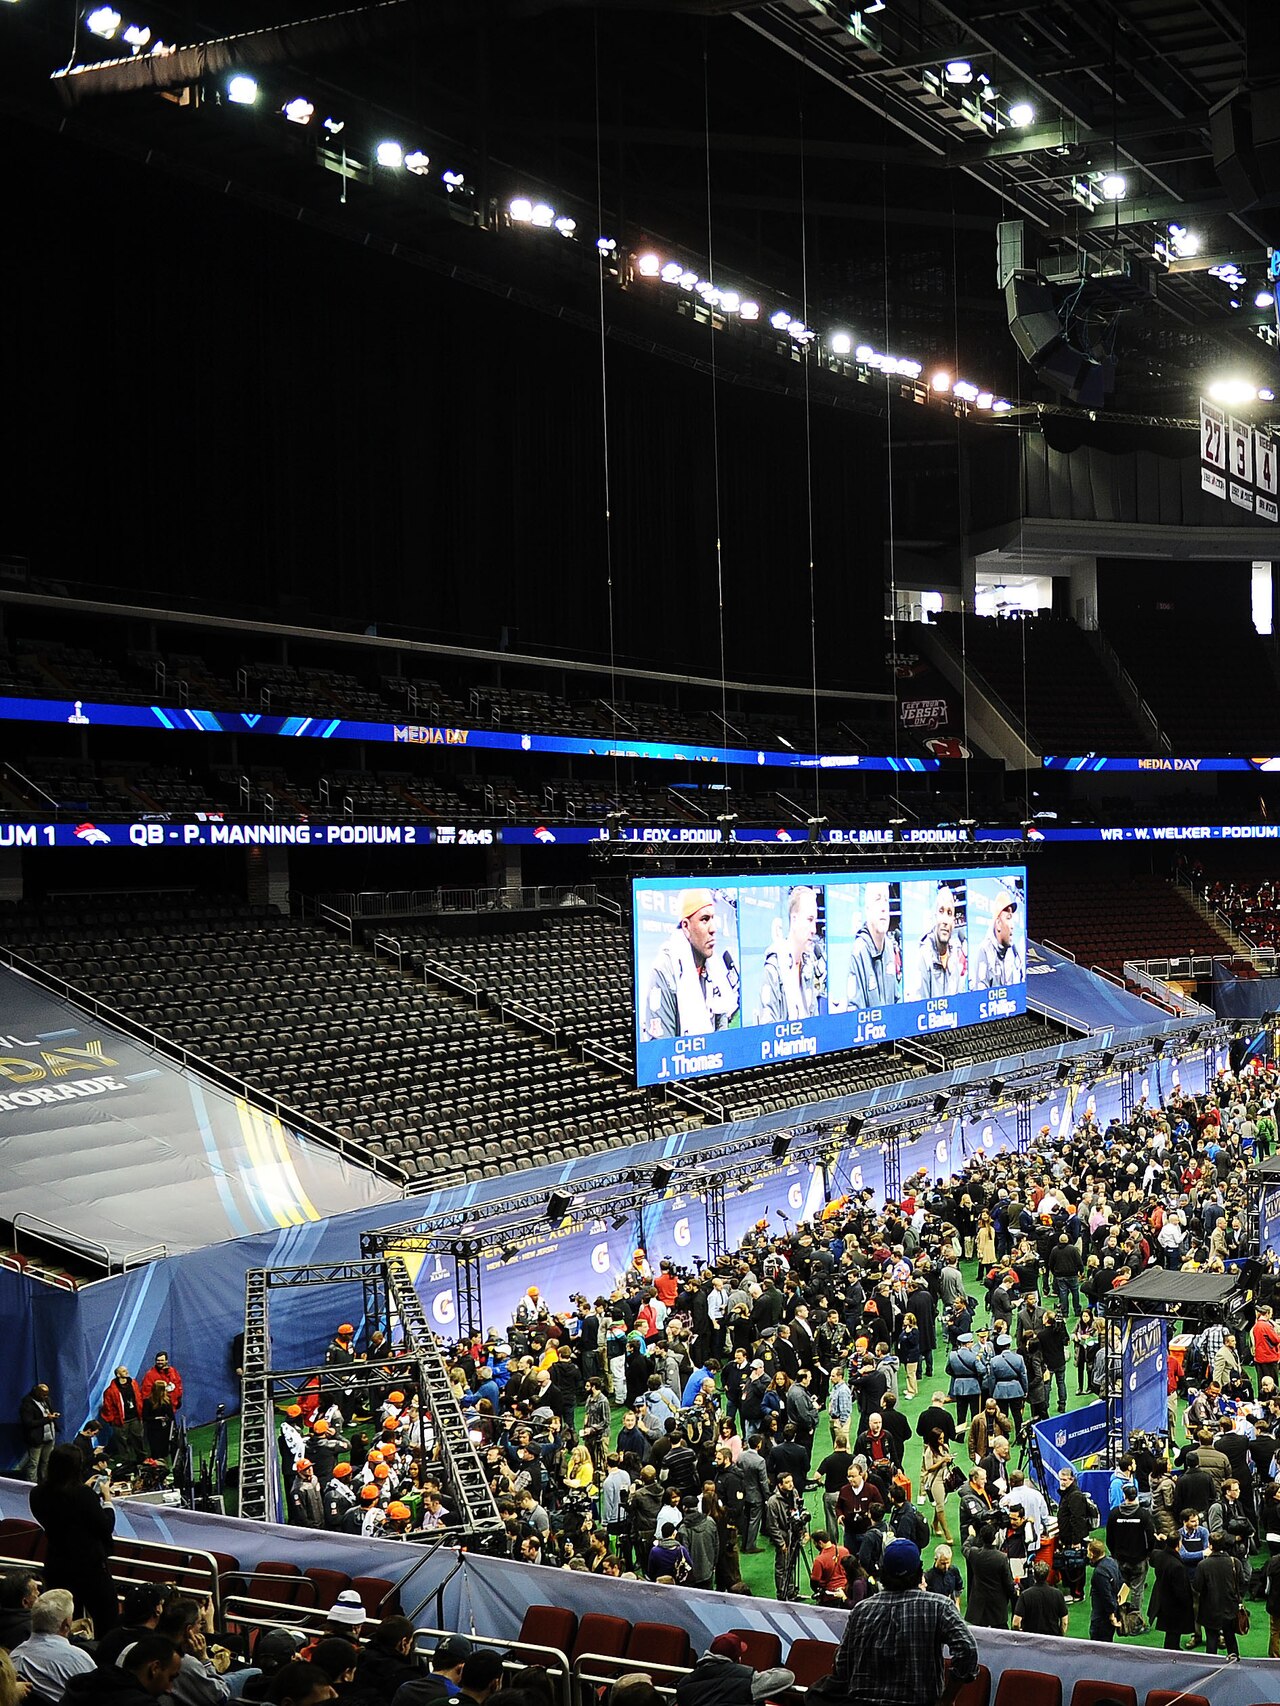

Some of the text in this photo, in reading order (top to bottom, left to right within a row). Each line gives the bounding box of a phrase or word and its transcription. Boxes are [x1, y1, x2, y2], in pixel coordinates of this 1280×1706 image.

[1205, 418, 1221, 463] 27
[1236, 437, 1246, 477] 3
[1263, 452, 1272, 490] 4
[901, 706, 948, 720] JERSEY
[394, 725, 444, 744] MEDIA
[1138, 758, 1202, 771] MEDIA DAY
[43, 825, 56, 846] 1
[130, 824, 164, 846] QB
[184, 824, 206, 844] P.
[211, 825, 310, 844] MANNING
[327, 826, 401, 844] PODIUM
[404, 826, 416, 843] 2
[458, 829, 493, 845] 26:45
[643, 829, 722, 842] FOX PODIU
[829, 830, 843, 842] CB
[861, 830, 893, 842] BAILE
[909, 830, 957, 842] PODIUM
[1100, 828, 1123, 840] WR
[1134, 828, 1150, 840] W.
[1153, 827, 1211, 840] WELKER
[1222, 826, 1277, 838] PODIUM
[988, 989, 998, 1000] CH
[927, 1000, 937, 1012] CH
[979, 1003, 988, 1019] S.
[858, 1011, 869, 1024] CH
[917, 1010, 958, 1031] C. Bailey
[775, 1024, 788, 1038] CH
[853, 1023, 887, 1043] J. Fox
[675, 1040, 691, 1054] CH
[761, 1035, 817, 1060] P. Manning
[657, 1053, 723, 1078] J. Thomas
[1132, 1325, 1161, 1363] XLVIII
